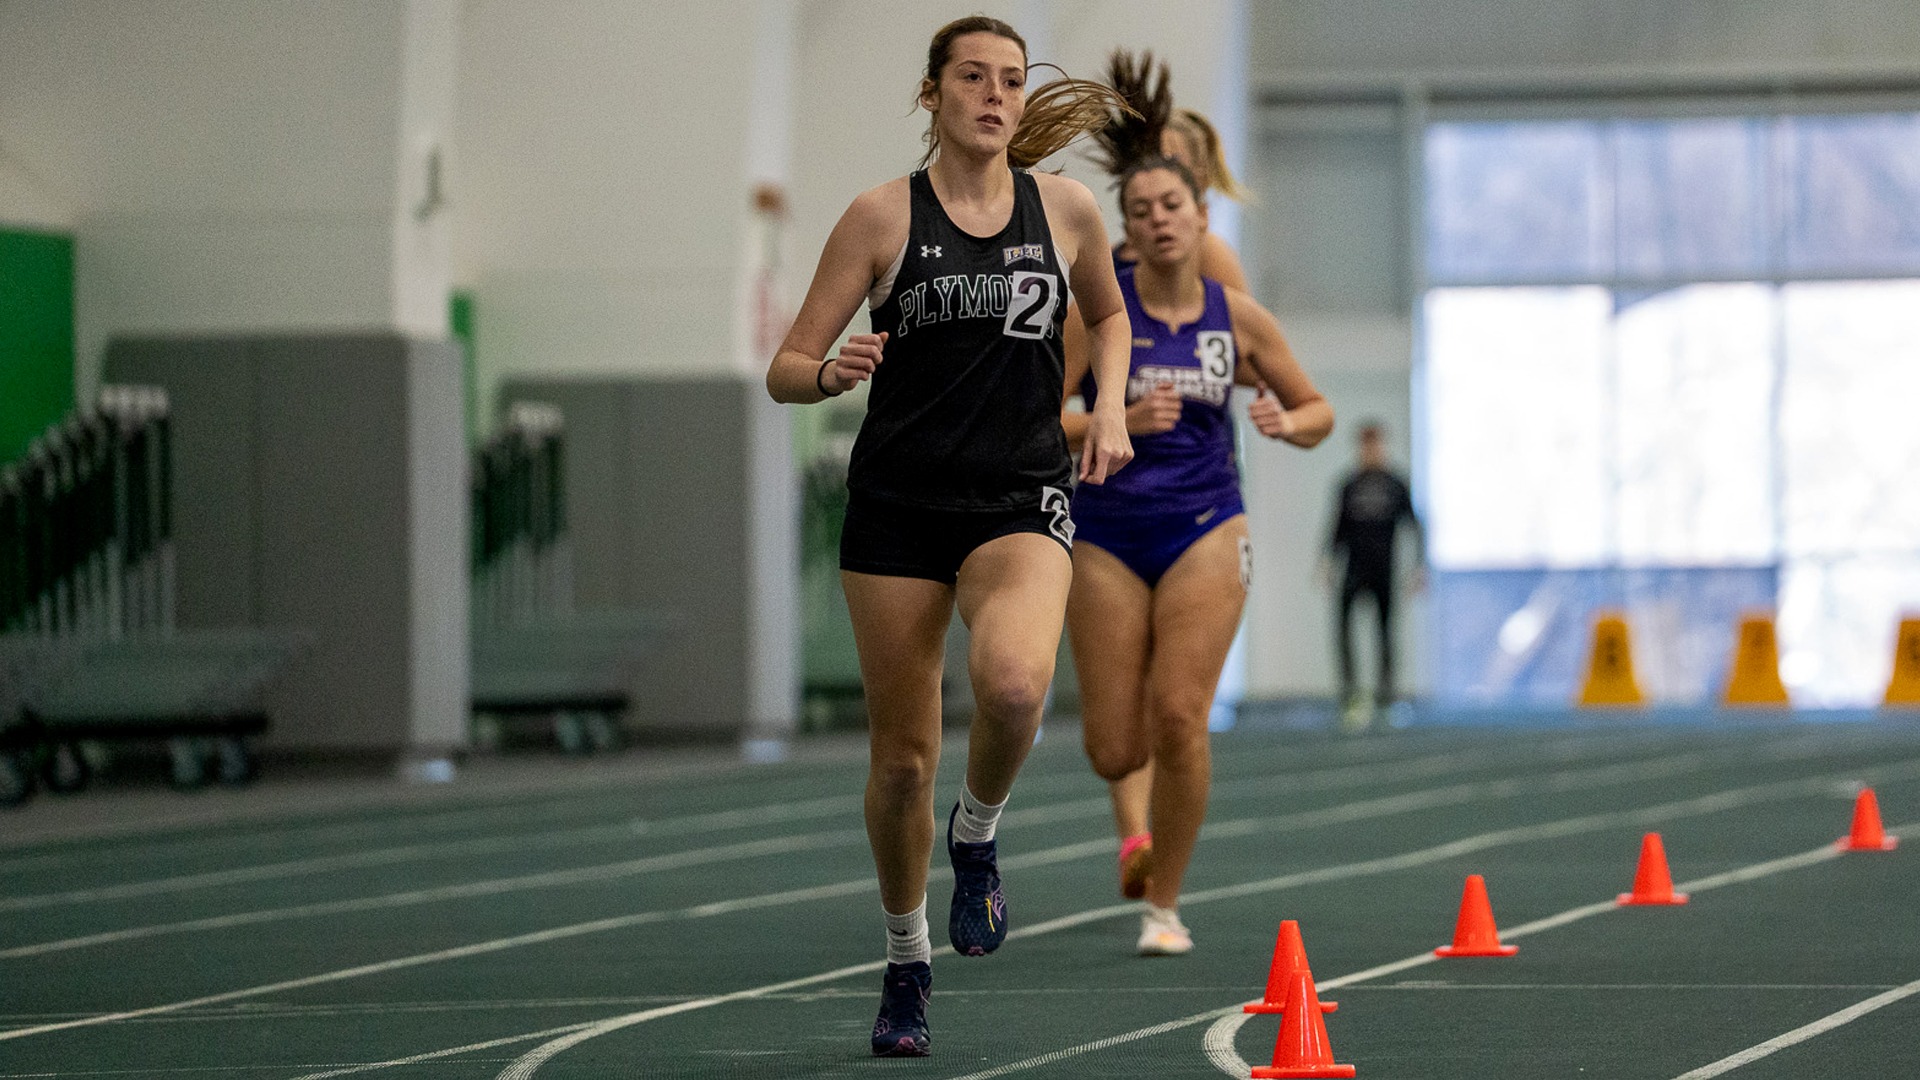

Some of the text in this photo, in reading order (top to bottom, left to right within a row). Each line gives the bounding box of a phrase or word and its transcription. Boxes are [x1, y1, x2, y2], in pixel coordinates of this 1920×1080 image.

[1010, 276, 1050, 335] 2
[1139, 366, 1203, 381] SAIN
[1207, 337, 1229, 378] 3
